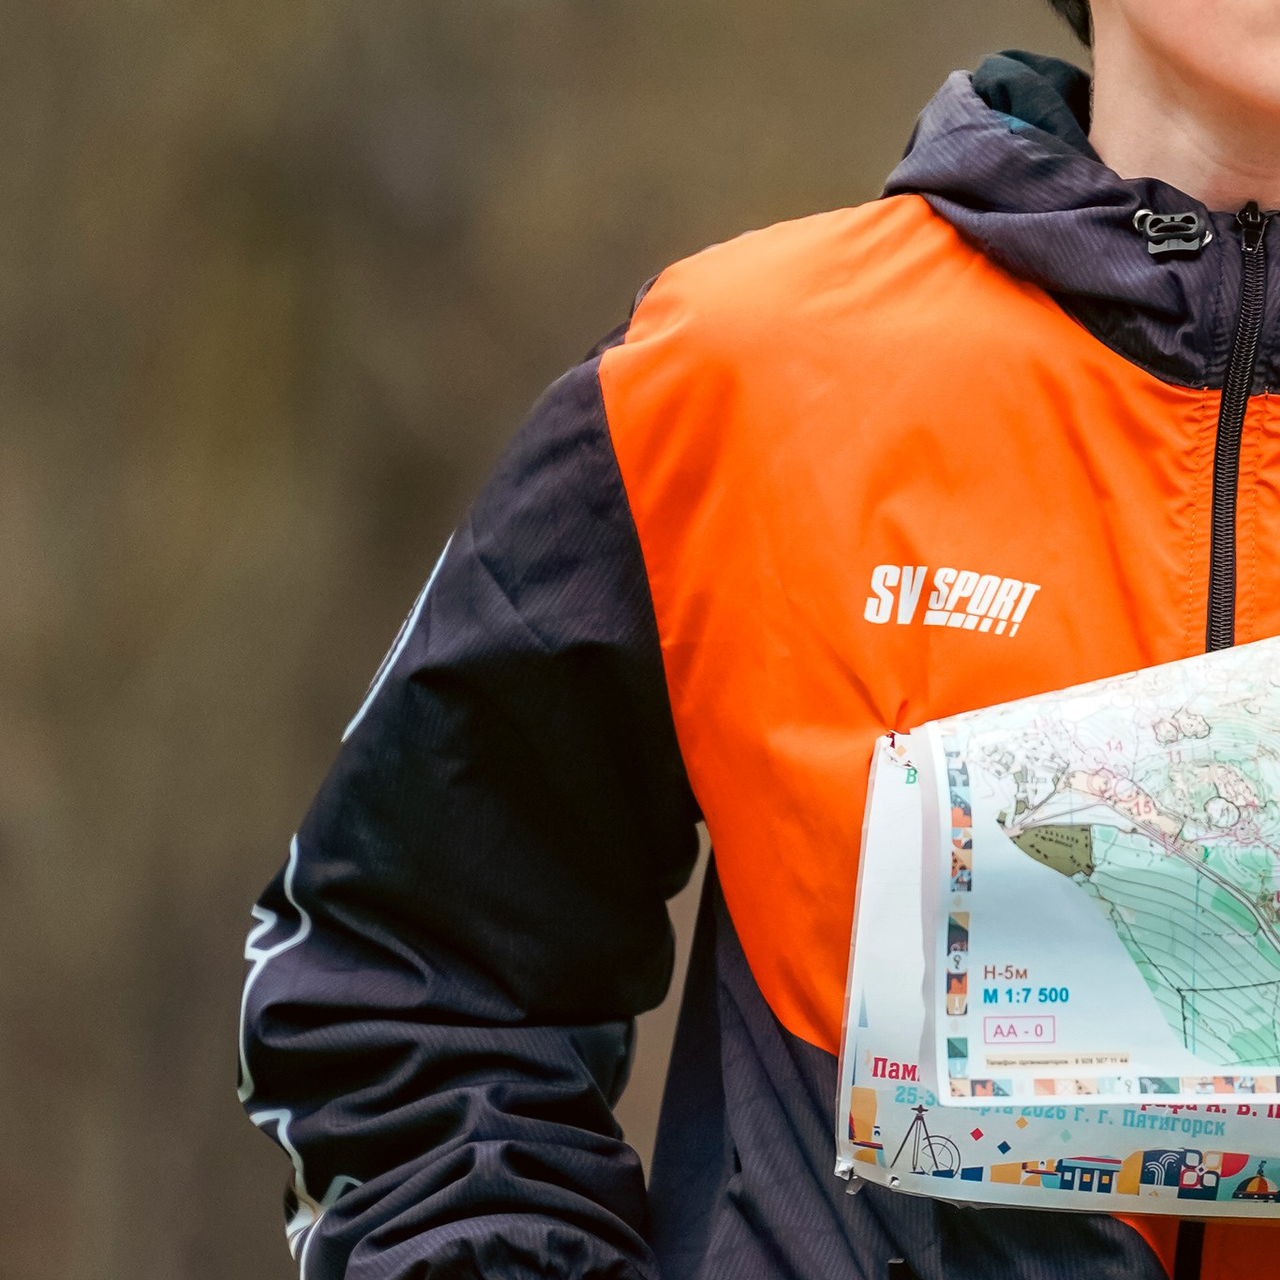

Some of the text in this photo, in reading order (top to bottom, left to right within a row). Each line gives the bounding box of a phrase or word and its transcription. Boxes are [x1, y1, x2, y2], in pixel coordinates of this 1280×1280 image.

[863, 564, 1041, 625] SV SPORT
[1134, 802, 1153, 816] 15
[983, 965, 1028, 980] Н-5м
[983, 987, 1069, 1004] М 1:7 500
[872, 1057, 920, 1082] Пам
[895, 1085, 940, 1107] 25-3
[1122, 1109, 1226, 1138] Пятигорск
